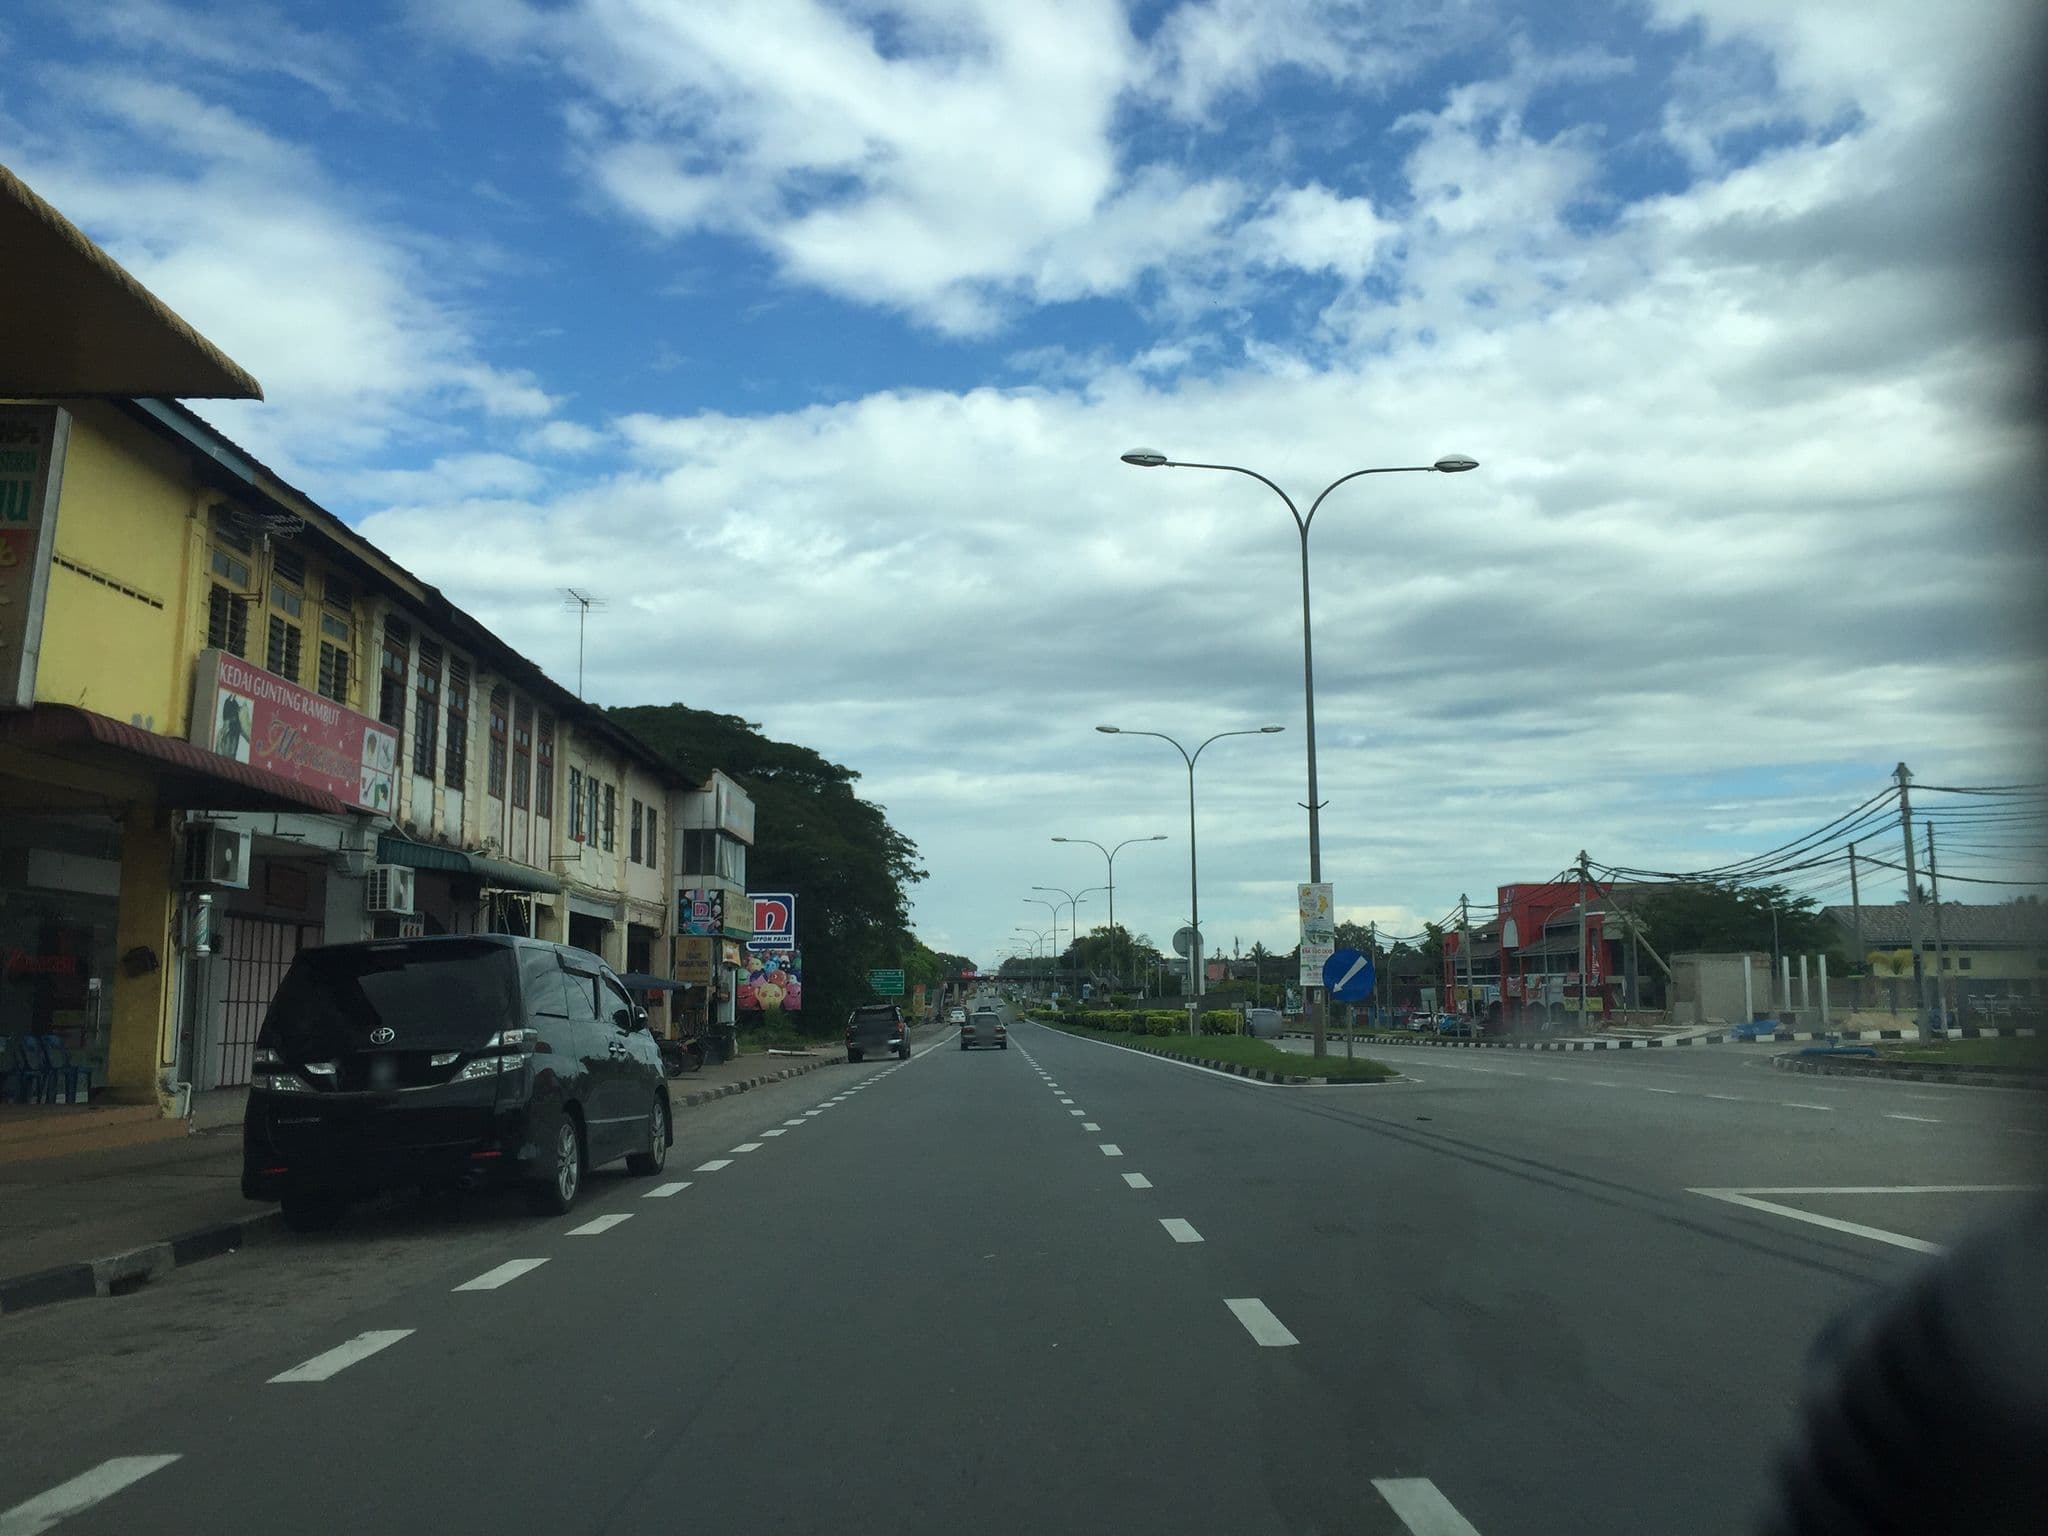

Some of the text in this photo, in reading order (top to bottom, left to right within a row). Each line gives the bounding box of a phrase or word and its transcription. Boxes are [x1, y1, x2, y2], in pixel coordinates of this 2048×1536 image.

[220, 663, 341, 727] KEDAI GUNTING RAMBUT
